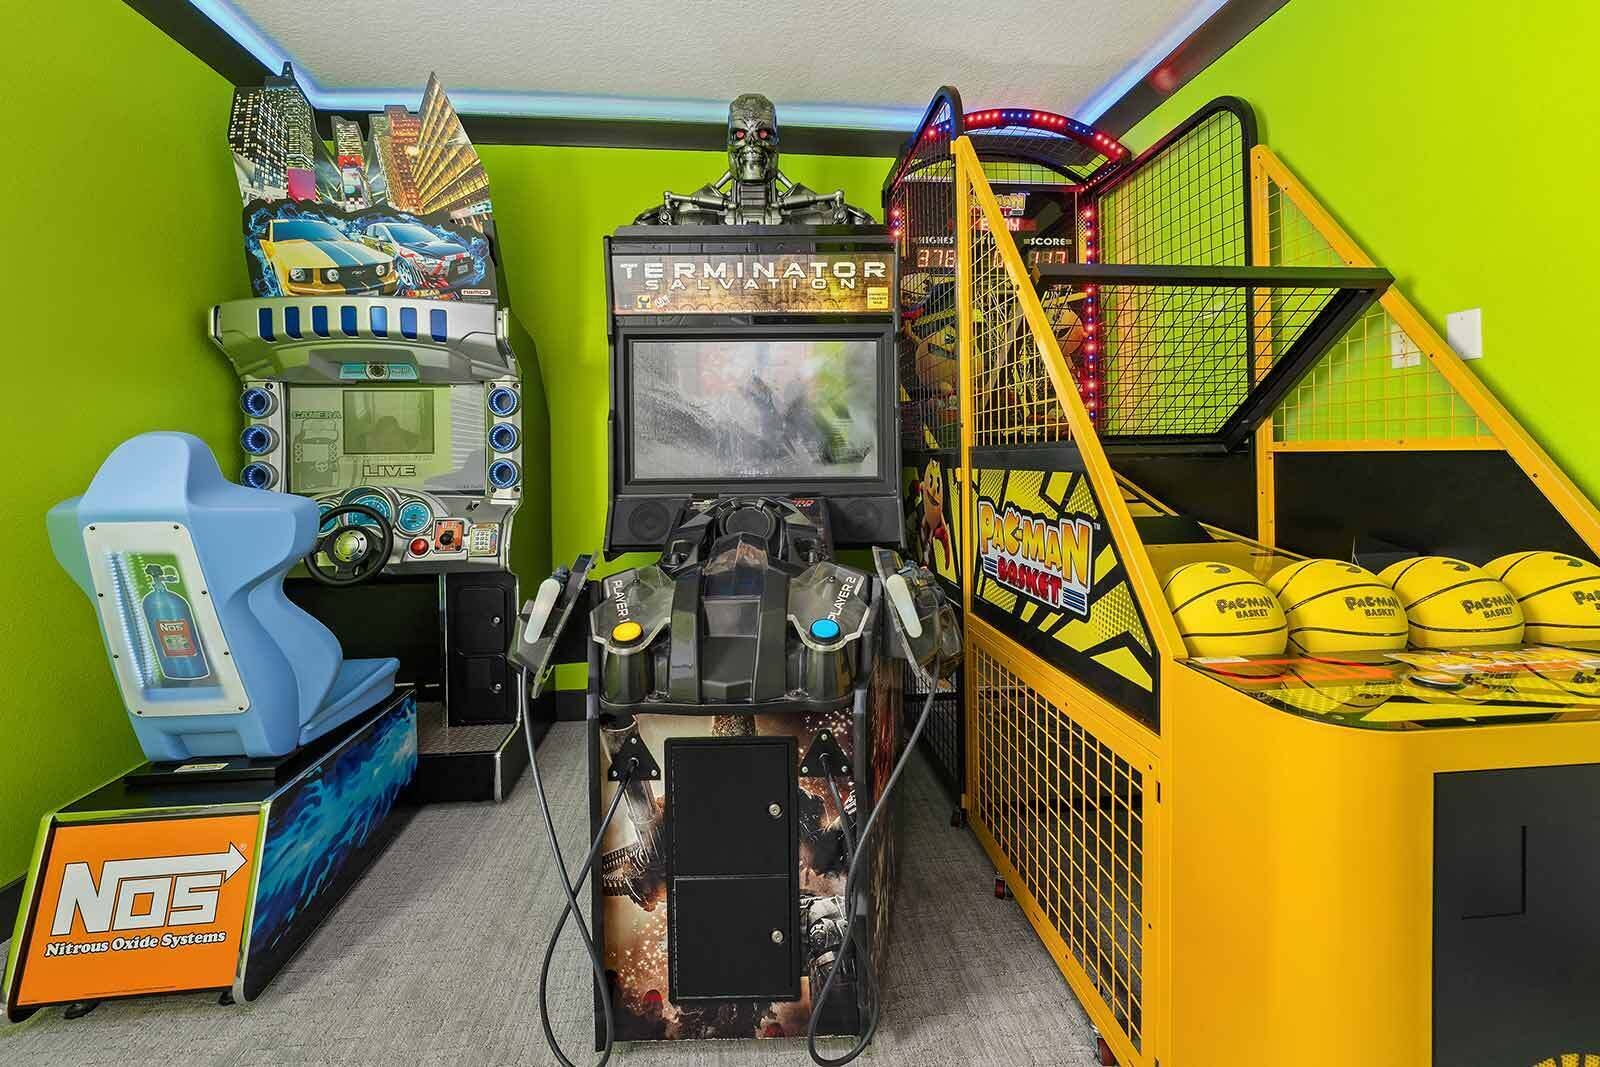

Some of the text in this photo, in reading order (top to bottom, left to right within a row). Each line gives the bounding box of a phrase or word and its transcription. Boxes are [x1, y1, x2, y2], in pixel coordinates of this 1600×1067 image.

[918, 236, 954, 244] HIGHES
[1030, 237, 1066, 246] SCORE
[620, 261, 886, 279] TERMINATOR
[645, 278, 856, 290] SALVATION
[362, 465, 416, 477] LIVE
[979, 502, 1092, 589] PAC-MAN
[997, 556, 1063, 605] BASKET
[612, 580, 629, 617] PLAYER
[827, 584, 853, 621] PLAYER
[1236, 609, 1269, 619] BASKET
[1364, 608, 1396, 617] BASKET
[160, 623, 184, 632] NOS
[51, 855, 226, 936] NOS
[45, 931, 226, 957] Nitrous Oxide Systems
